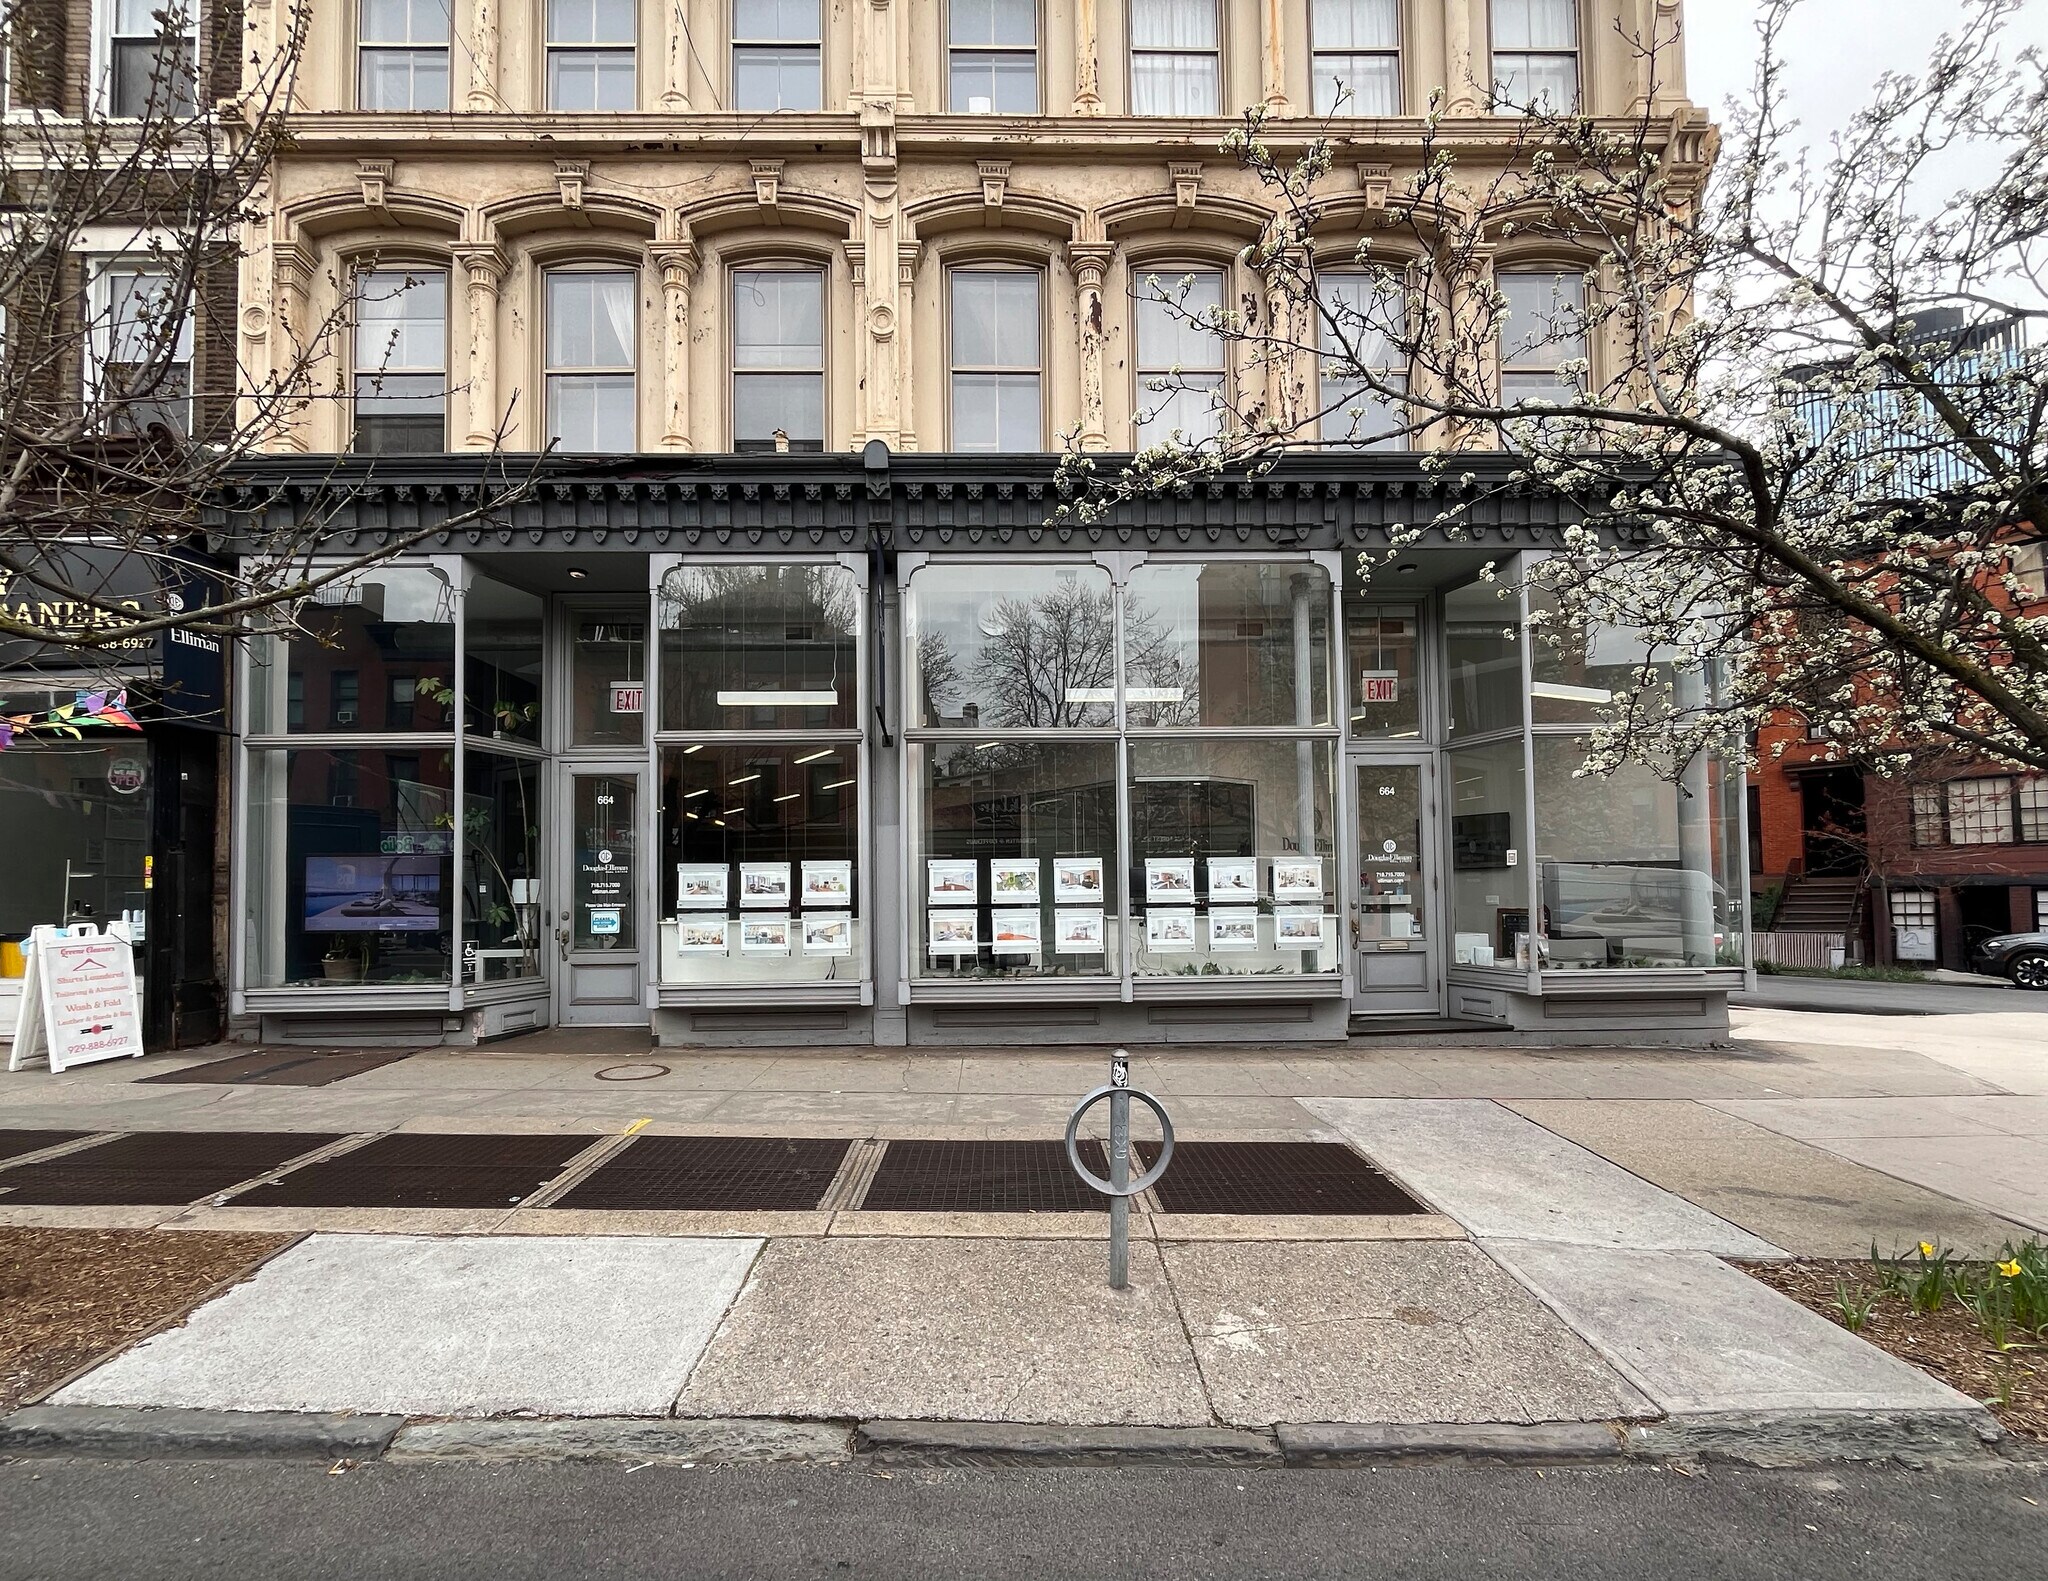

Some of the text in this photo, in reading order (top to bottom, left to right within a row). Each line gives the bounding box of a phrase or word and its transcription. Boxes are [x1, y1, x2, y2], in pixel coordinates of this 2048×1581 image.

[171, 628, 220, 653] Elliman
[1368, 680, 1393, 700] EXIT
[616, 691, 643, 711] EXIT
[109, 775, 142, 787] OPEN
[1379, 786, 1395, 796] 664
[597, 795, 614, 805] 664
[582, 864, 605, 873] Douglas
[605, 864, 629, 872] Elliman
[86, 945, 115, 954] Cleaners
[66, 998, 122, 1012] Wash & Fold
[68, 1036, 129, 1054] 929-888-6927
